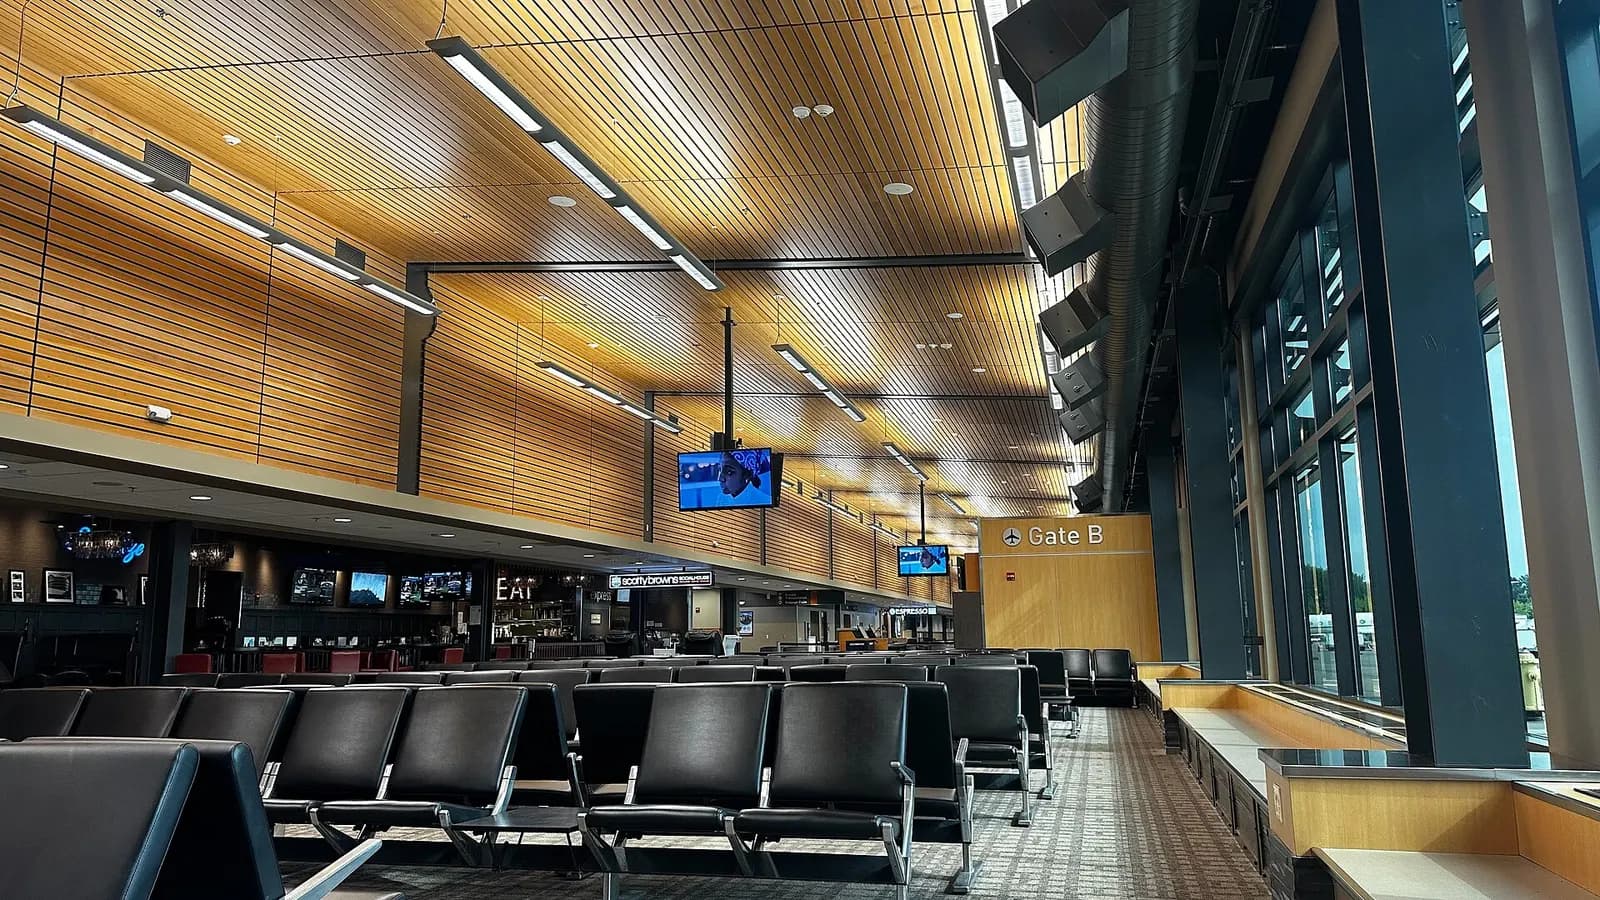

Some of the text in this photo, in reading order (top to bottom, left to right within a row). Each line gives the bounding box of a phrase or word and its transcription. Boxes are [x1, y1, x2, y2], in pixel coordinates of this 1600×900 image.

[1028, 525, 1104, 546] Gate B
[895, 607, 928, 615] ESPRESSO
